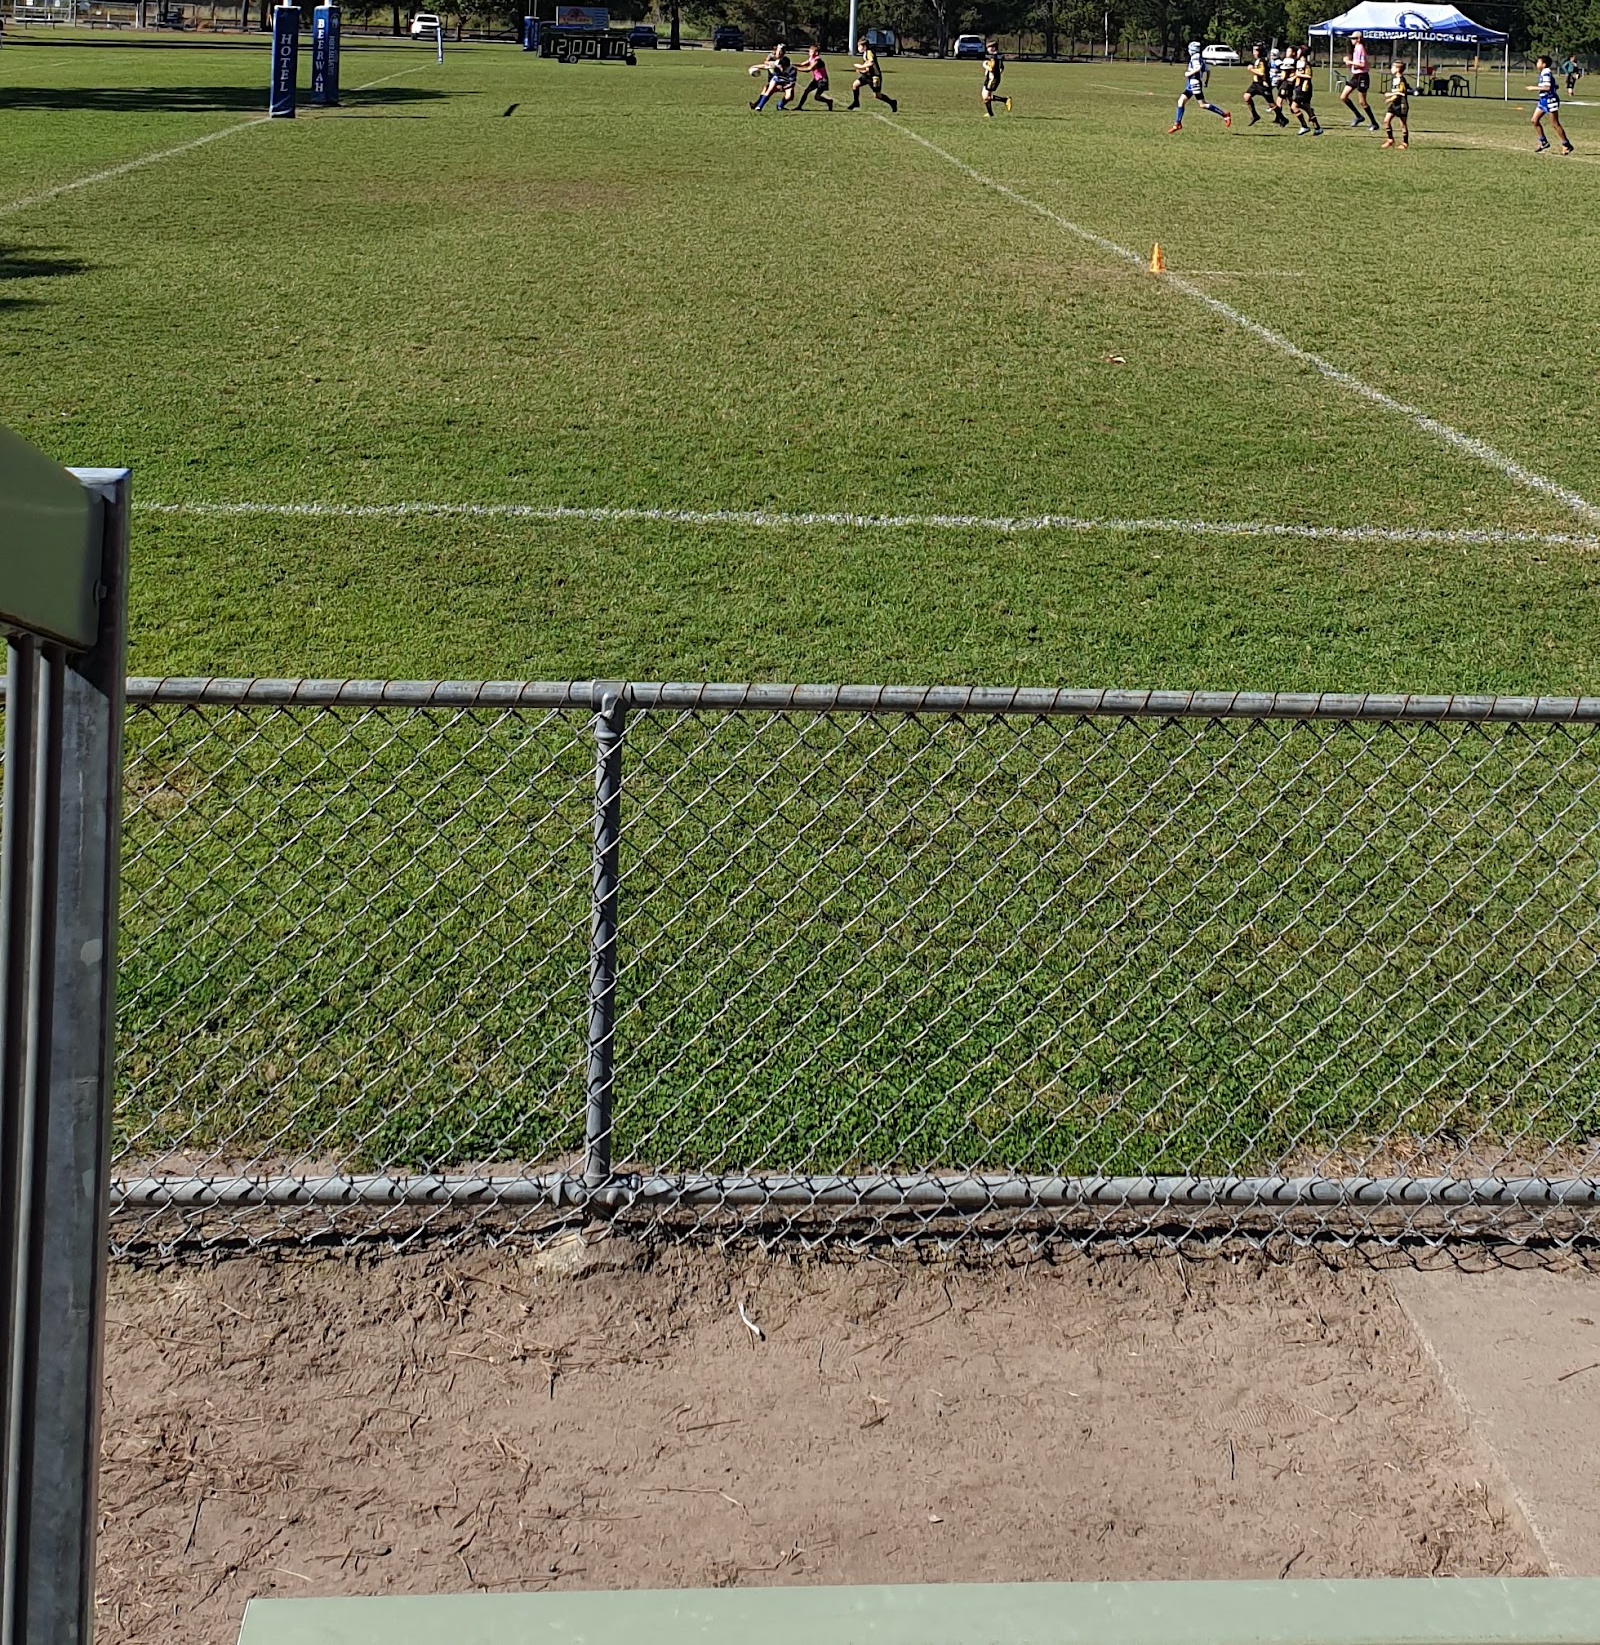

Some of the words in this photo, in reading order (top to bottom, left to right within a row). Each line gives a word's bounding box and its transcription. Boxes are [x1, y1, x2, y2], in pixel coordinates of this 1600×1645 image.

[280, 33, 292, 92] HOTEL
[315, 19, 325, 92] BEERWAH
[1363, 31, 1407, 40] BEERWAH
[1408, 31, 1455, 41] BULLDOGS
